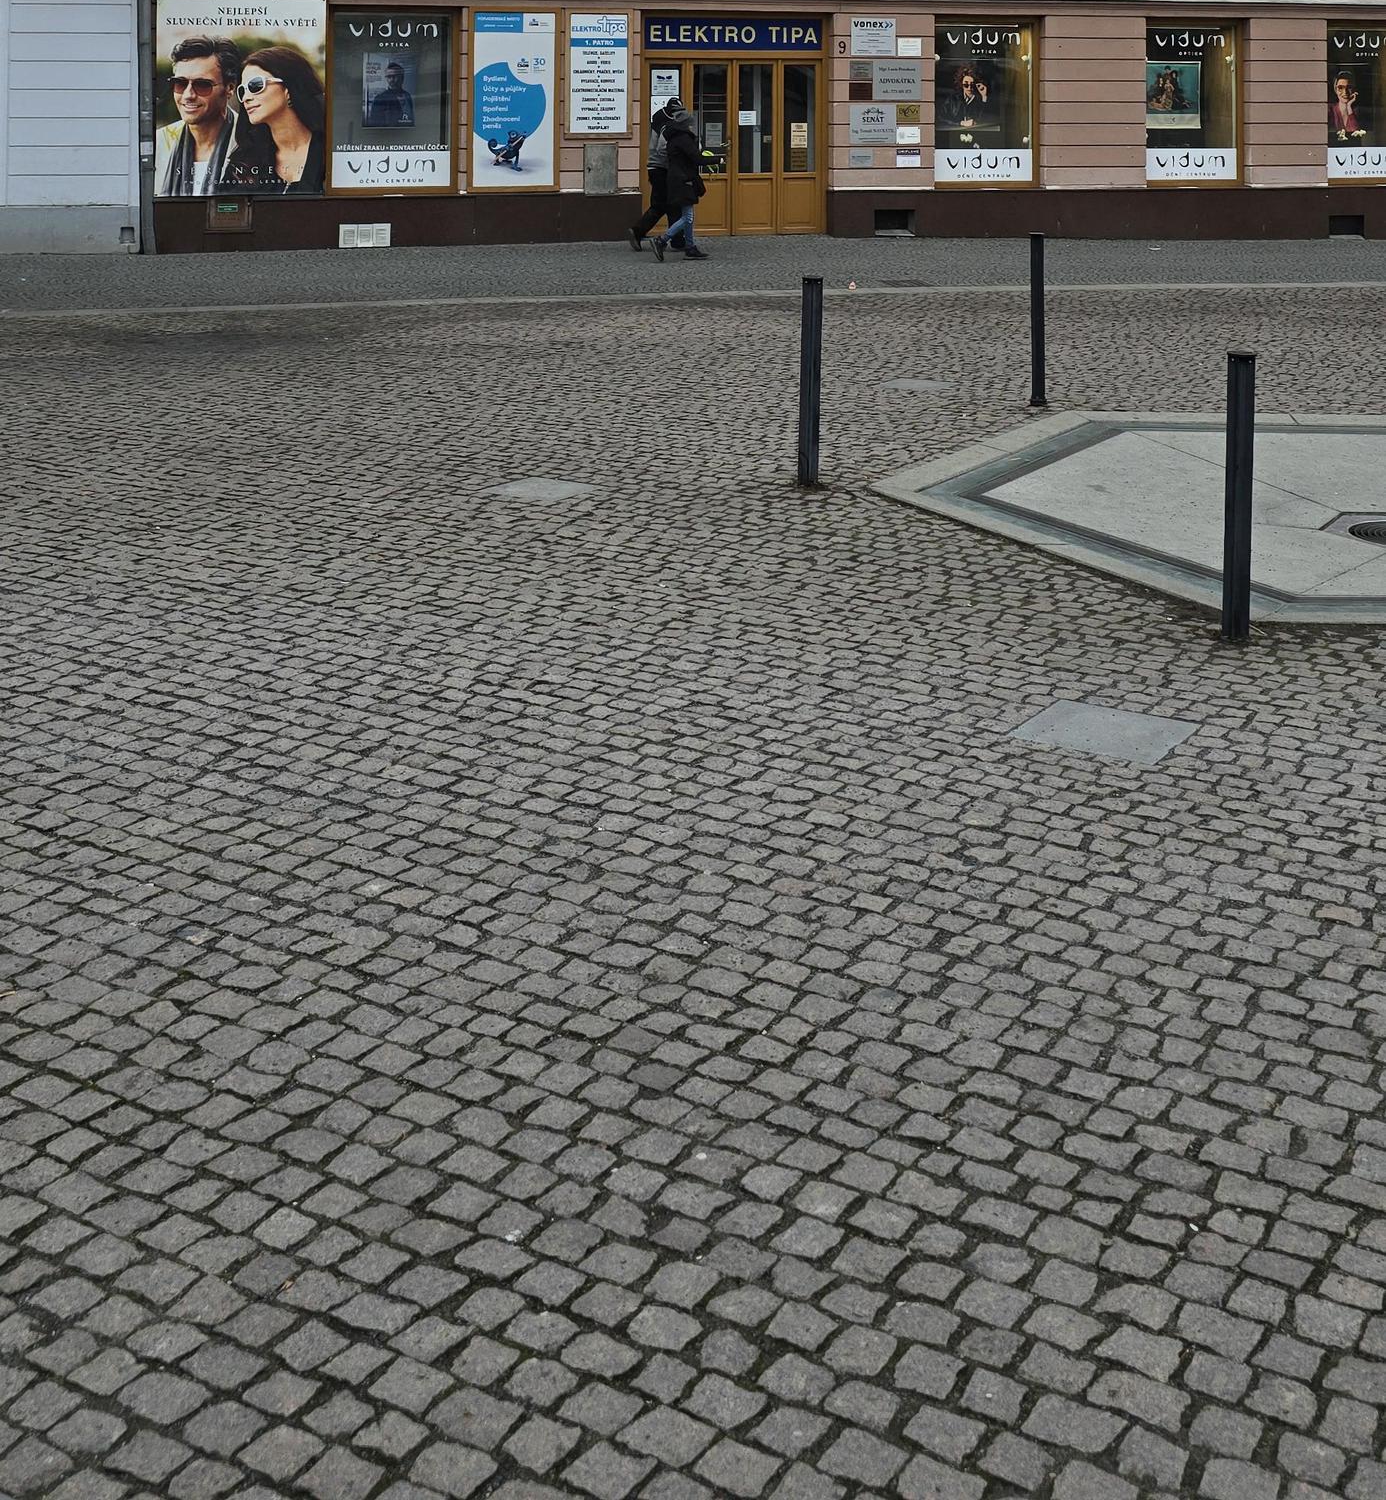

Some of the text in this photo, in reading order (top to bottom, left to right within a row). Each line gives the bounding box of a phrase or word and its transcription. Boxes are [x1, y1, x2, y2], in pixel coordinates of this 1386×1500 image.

[217, 6, 268, 15] NEJLEPŠÍ
[166, 16, 318, 27] SLUNEČNÍ BRÝLE NA SVĚTĚ
[349, 19, 438, 37] vidum
[597, 15, 626, 36] tipa
[853, 20, 884, 28] vonex
[650, 25, 818, 44] ELEKTRO TIPA
[947, 28, 1021, 45] vidum
[1155, 31, 1225, 47] vidum
[1333, 32, 1386, 48] vidu
[838, 41, 846, 54] 9
[533, 58, 546, 66] 30
[483, 85, 499, 93] Účty
[862, 115, 885, 123] SENÁT
[347, 156, 436, 173] vidum
[946, 153, 1021, 169] vidum
[1155, 152, 1225, 168] vidum
[1335, 150, 1386, 166] vidu
